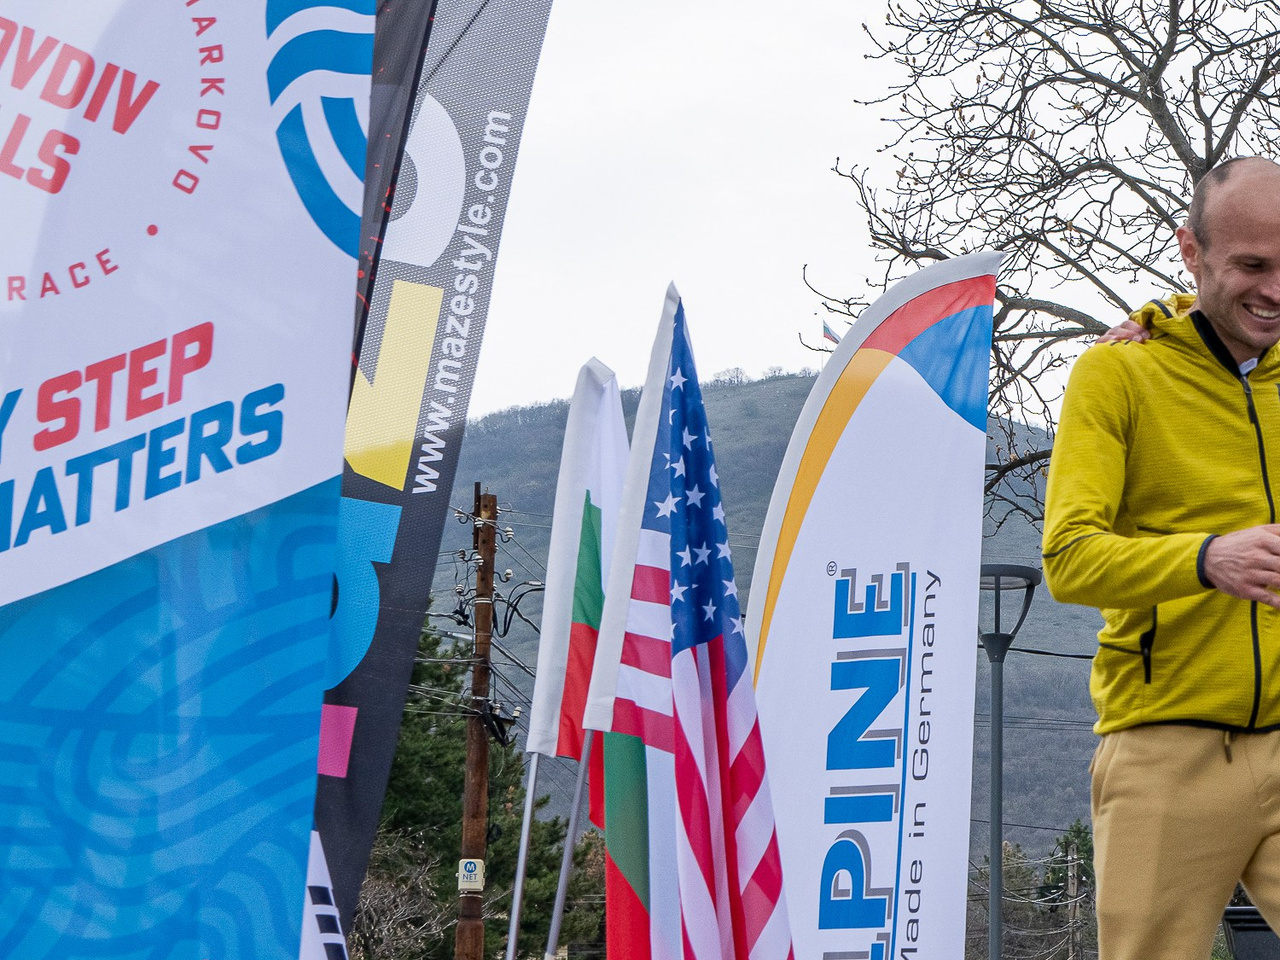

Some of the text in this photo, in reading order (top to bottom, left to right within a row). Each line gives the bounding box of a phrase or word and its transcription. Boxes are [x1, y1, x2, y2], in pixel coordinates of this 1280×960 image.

[172, 0, 225, 194] ARKOVO
[7, 248, 119, 300] RACE
[412, 109, 512, 495] www.mazestyle.com
[33, 321, 214, 451] STEP
[911, 568, 943, 783] Germany
[462, 873, 478, 881] NET
[909, 801, 926, 839] in
